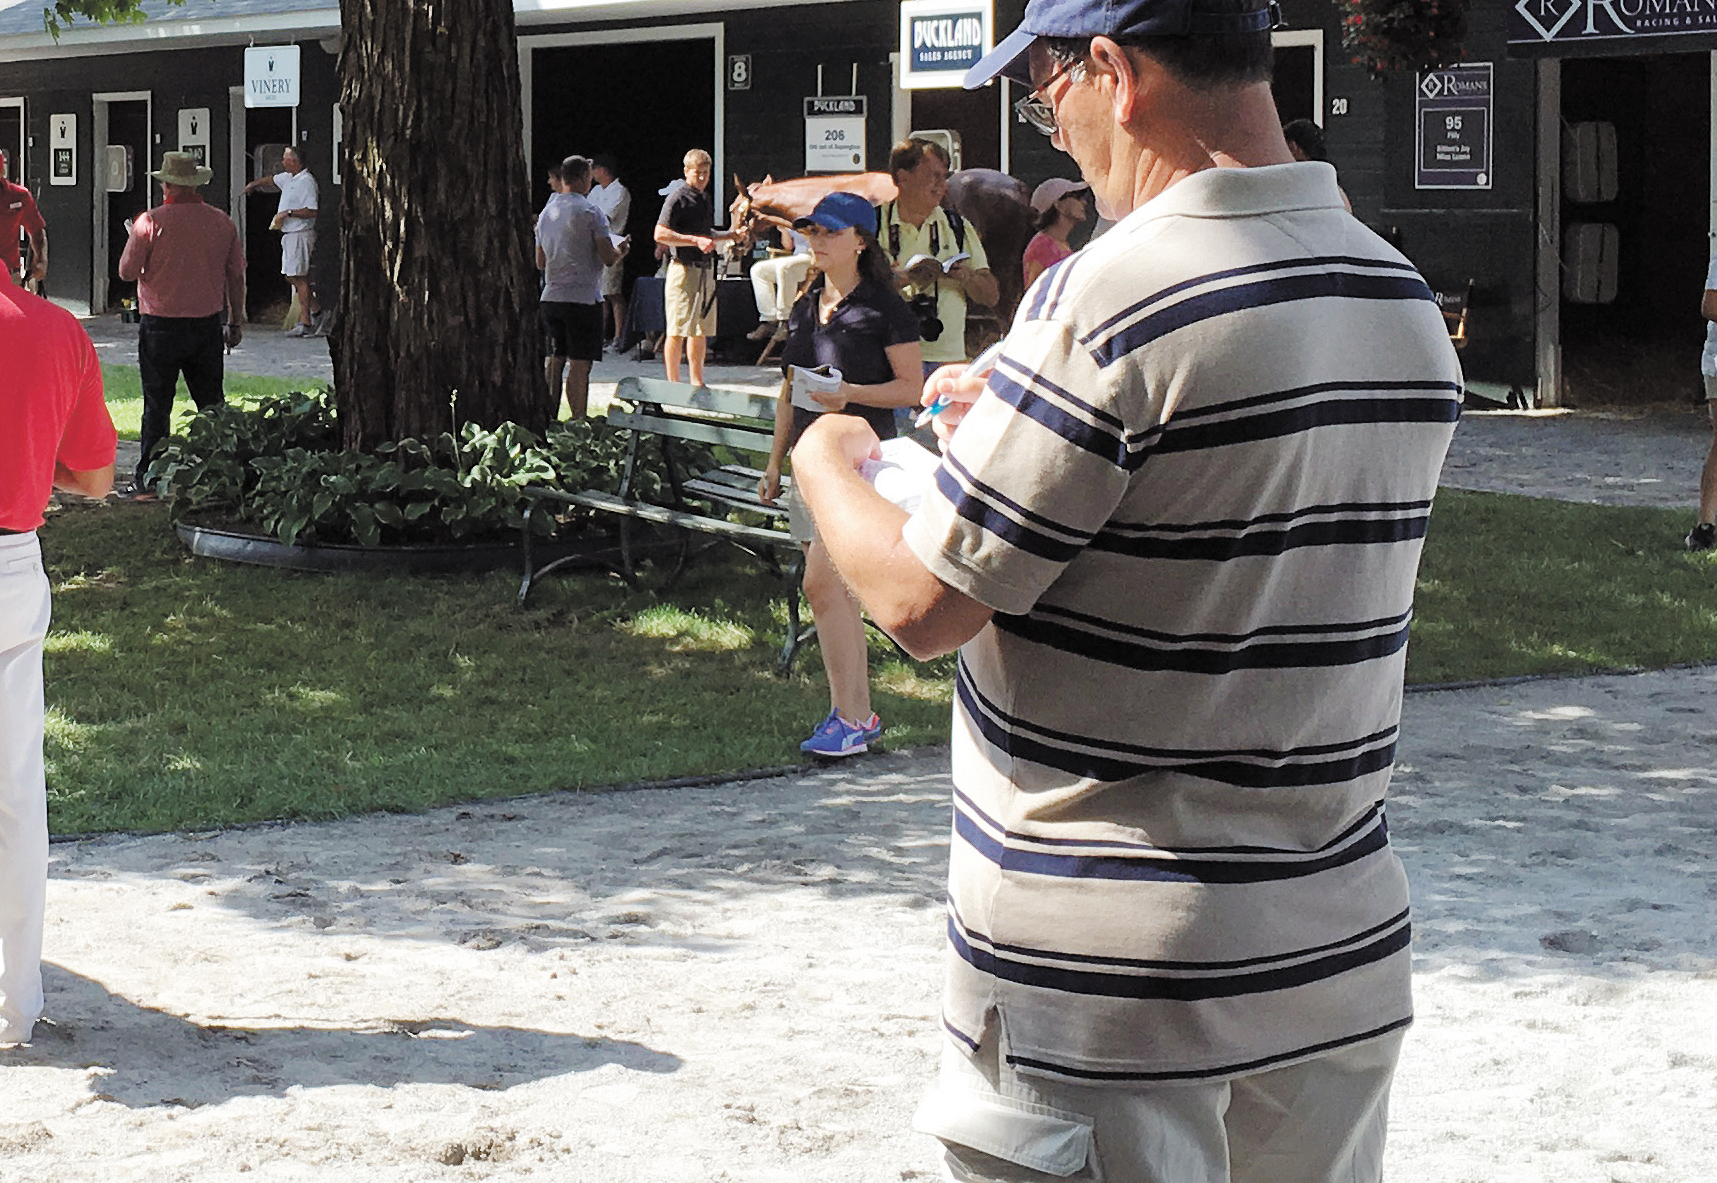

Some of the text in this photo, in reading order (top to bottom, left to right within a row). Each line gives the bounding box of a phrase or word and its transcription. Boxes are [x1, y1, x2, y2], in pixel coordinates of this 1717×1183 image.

[1636, 18, 1679, 27] RACING
[913, 18, 981, 48] BUCKLAND
[919, 51, 942, 62] SALES
[732, 61, 747, 82] 8
[251, 79, 292, 94] VINERY
[813, 100, 856, 112] BUCKLAND
[1332, 98, 1348, 115] 20
[1445, 116, 1462, 129] 95
[824, 129, 846, 141] 206
